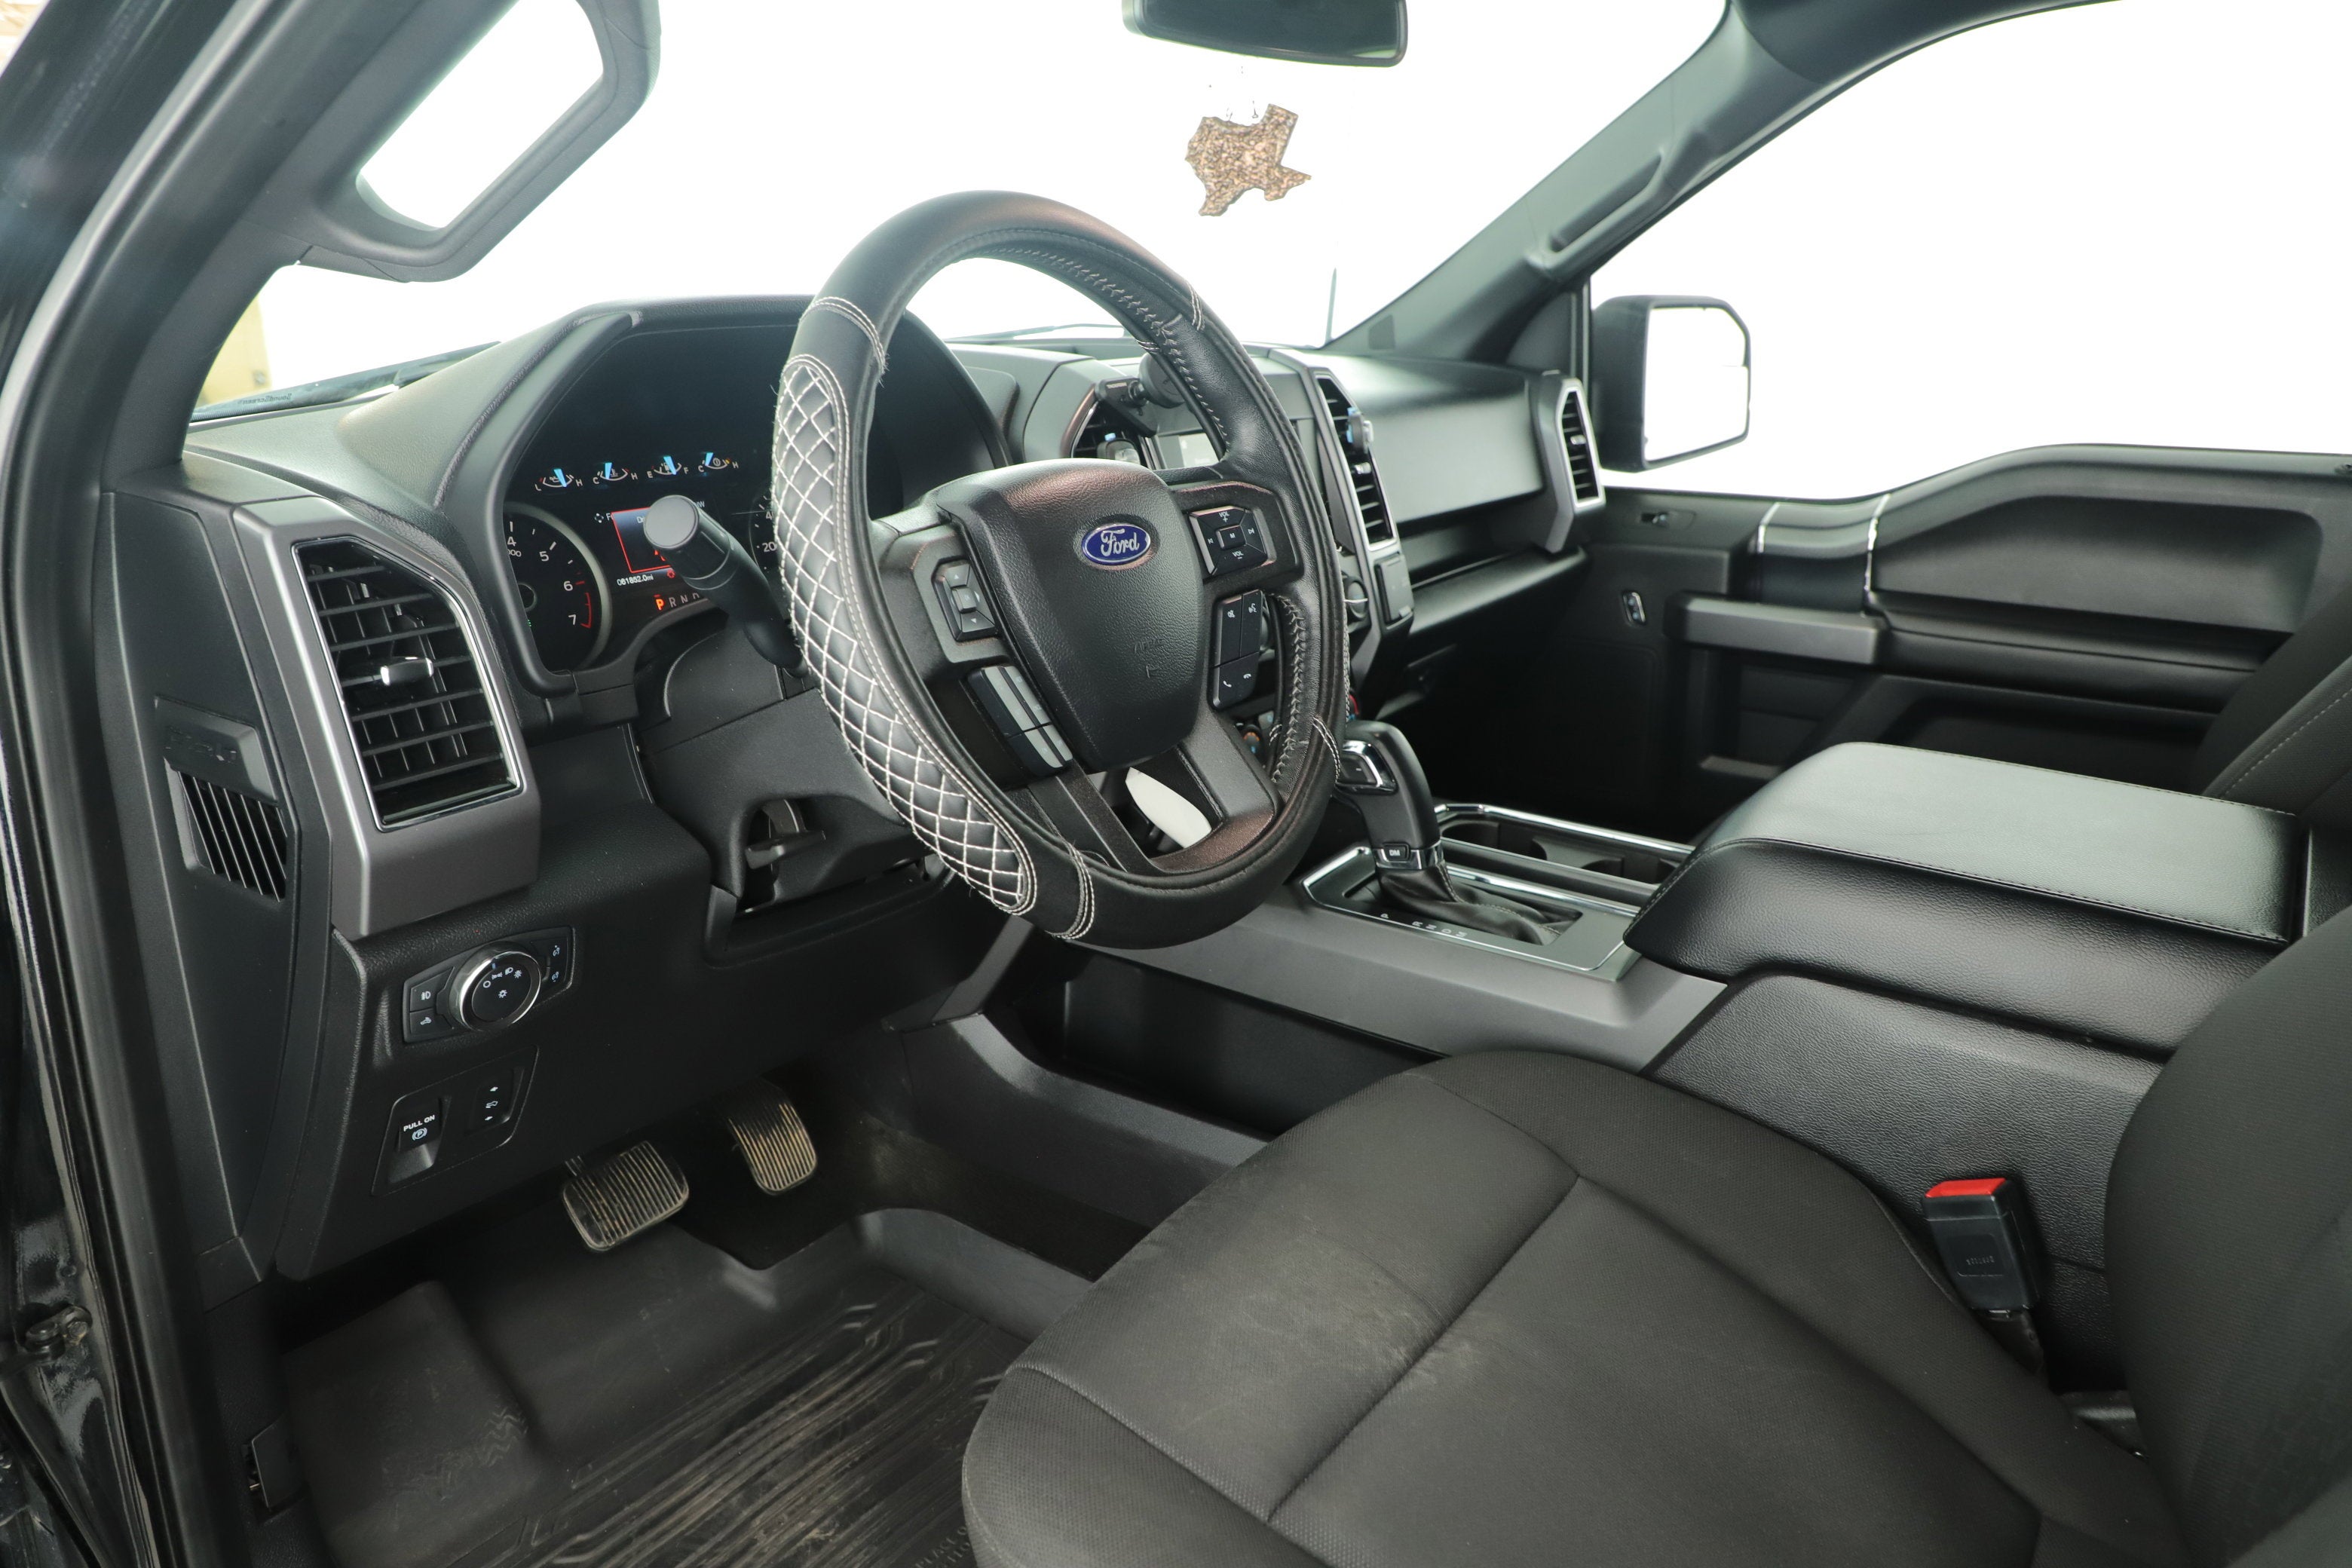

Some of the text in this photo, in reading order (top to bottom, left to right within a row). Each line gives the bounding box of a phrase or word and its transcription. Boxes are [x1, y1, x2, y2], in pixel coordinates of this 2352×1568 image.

[647, 470, 654, 479] E
[575, 479, 583, 487] H
[593, 476, 600, 485] C
[507, 536, 516, 547] 4
[1101, 528, 1140, 556] Ford
[539, 551, 550, 562] 5
[563, 580, 573, 591] 6
[655, 599, 665, 611] P
[669, 597, 677, 608] R
[680, 594, 688, 604] N
[568, 614, 576, 625] 7
[403, 1114, 435, 1132] PULL ON
